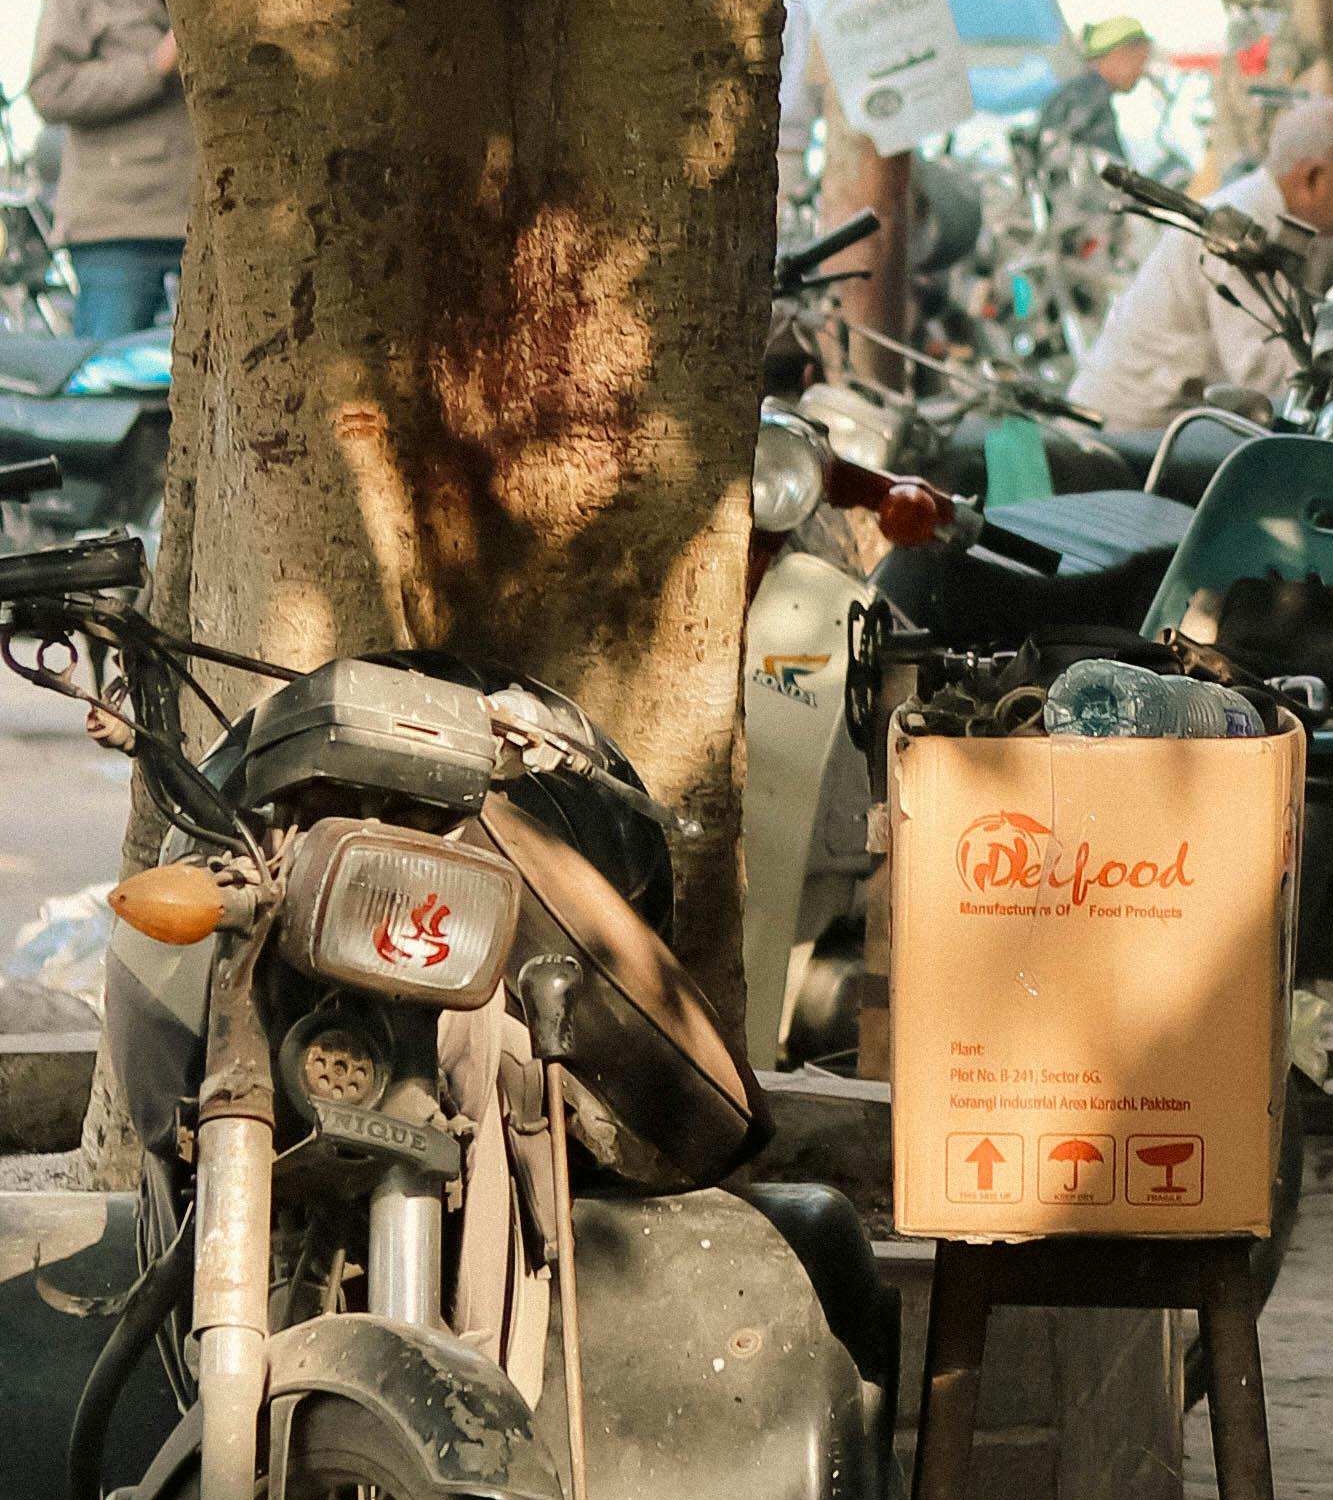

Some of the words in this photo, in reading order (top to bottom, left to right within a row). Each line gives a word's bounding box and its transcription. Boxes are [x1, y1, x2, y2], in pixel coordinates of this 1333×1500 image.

[1055, 903, 1071, 917] Of
[1089, 904, 1122, 919] Food
[1125, 905, 1183, 920] Products
[950, 1042, 985, 1056] Plant:
[950, 1068, 975, 1083] Plot
[977, 1069, 997, 1083] No.
[1041, 1069, 1080, 1084] Sector
[949, 1095, 997, 1112] Korangi
[1000, 1095, 1057, 1110] Industrial
[1059, 1097, 1088, 1110] Area
[1140, 1096, 1191, 1111] Pakistan
